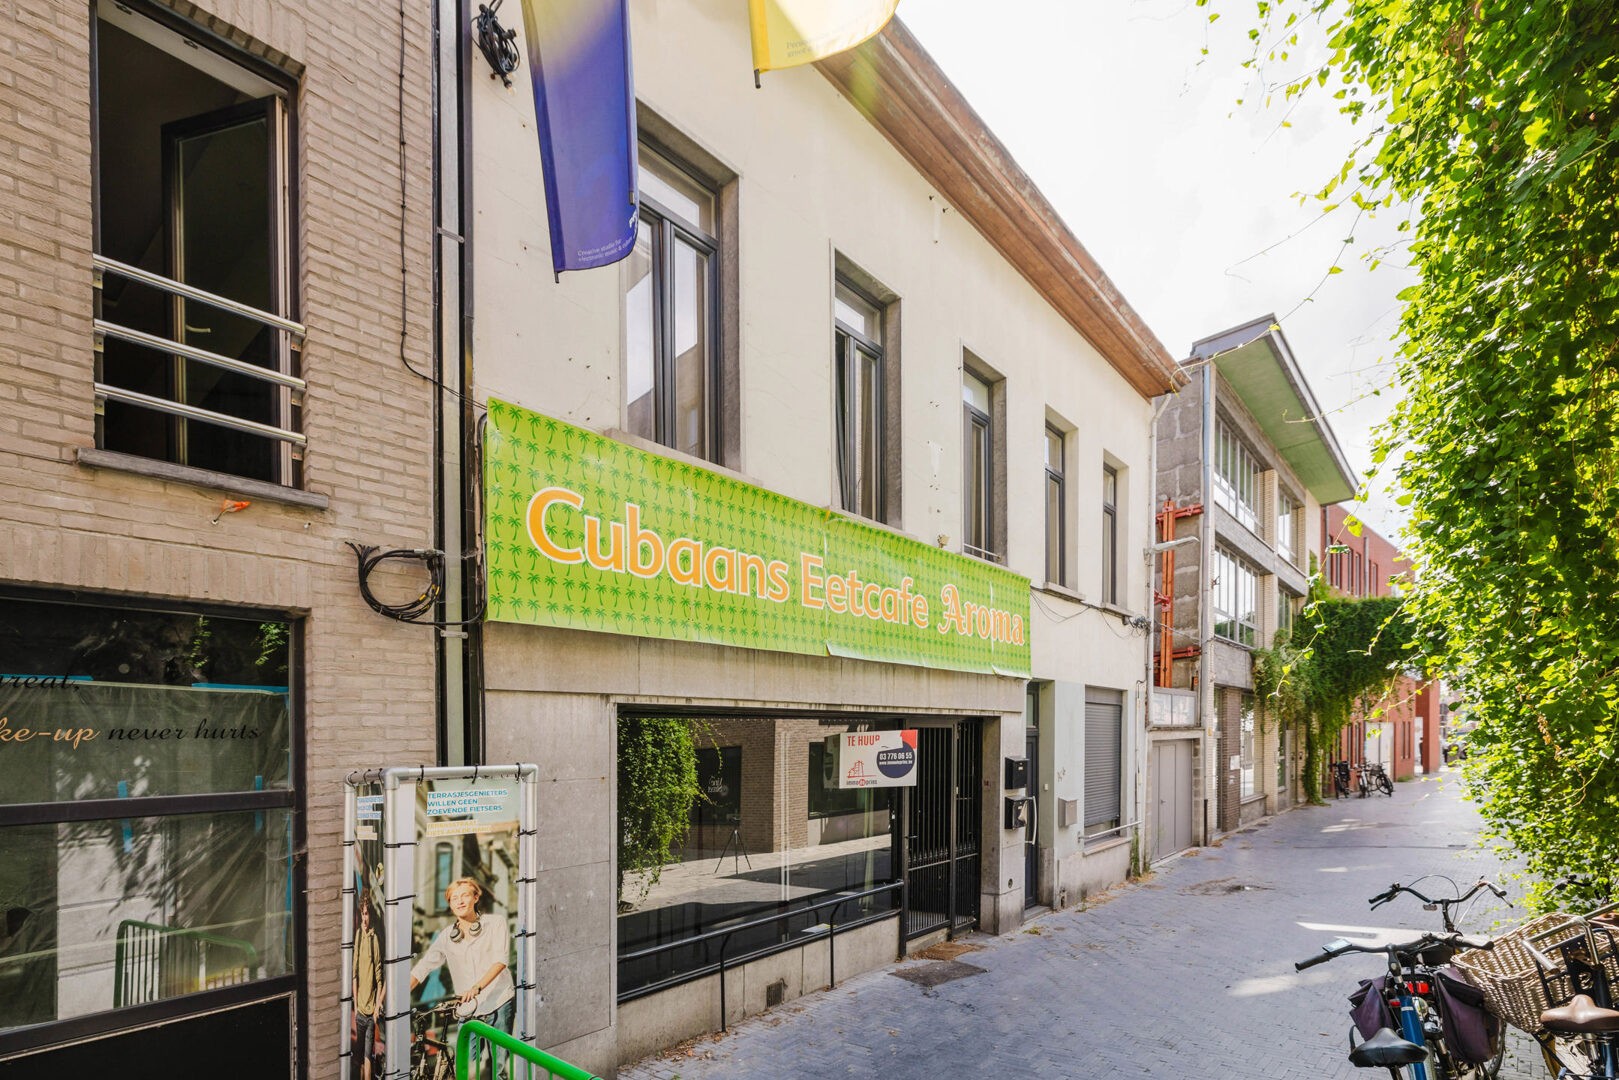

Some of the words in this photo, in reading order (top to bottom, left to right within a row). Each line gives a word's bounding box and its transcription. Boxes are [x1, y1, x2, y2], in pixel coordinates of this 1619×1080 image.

[526, 486, 790, 603] Cubaans
[800, 552, 929, 628] Eetcafe
[937, 583, 1025, 646] Aroma
[108, 727, 188, 741] never
[194, 718, 264, 740] hurts
[847, 736, 855, 746] TE
[427, 807, 468, 815] ZOEVENDE
